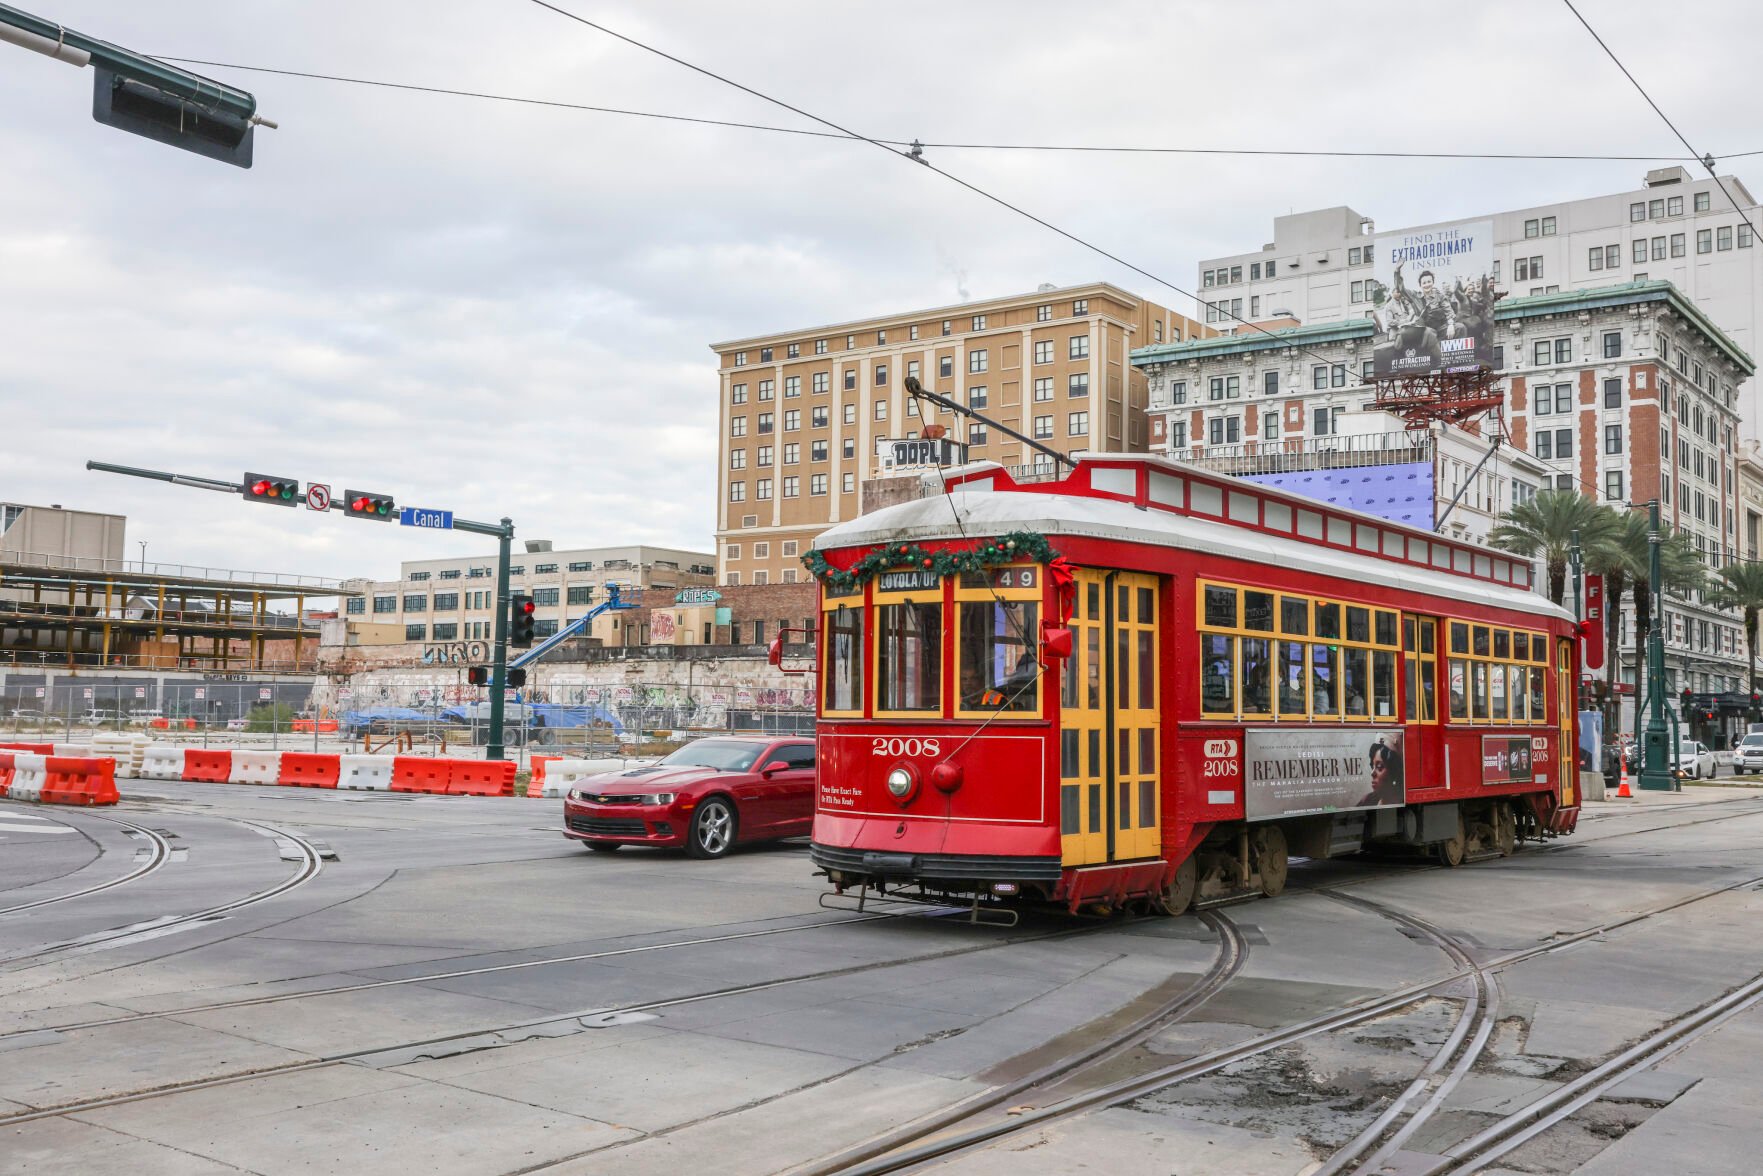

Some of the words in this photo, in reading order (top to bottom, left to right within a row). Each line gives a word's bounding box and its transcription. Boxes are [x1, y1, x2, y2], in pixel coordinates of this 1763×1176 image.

[1404, 234, 1433, 246] FIND
[1436, 230, 1460, 241] THE
[1392, 237, 1473, 263] EXTRAORDINARY
[1413, 257, 1452, 270] INSIDE
[1399, 356, 1430, 365] ATTRACTION
[413, 509, 444, 528] Canal
[872, 737, 941, 757] 2008
[1210, 743, 1223, 754] RTA
[1203, 760, 1238, 777] 2008
[1253, 757, 1339, 780] REMEMBER
[1342, 757, 1363, 776] ME
[840, 786, 851, 795] Exact
[852, 787, 862, 796] Fare
